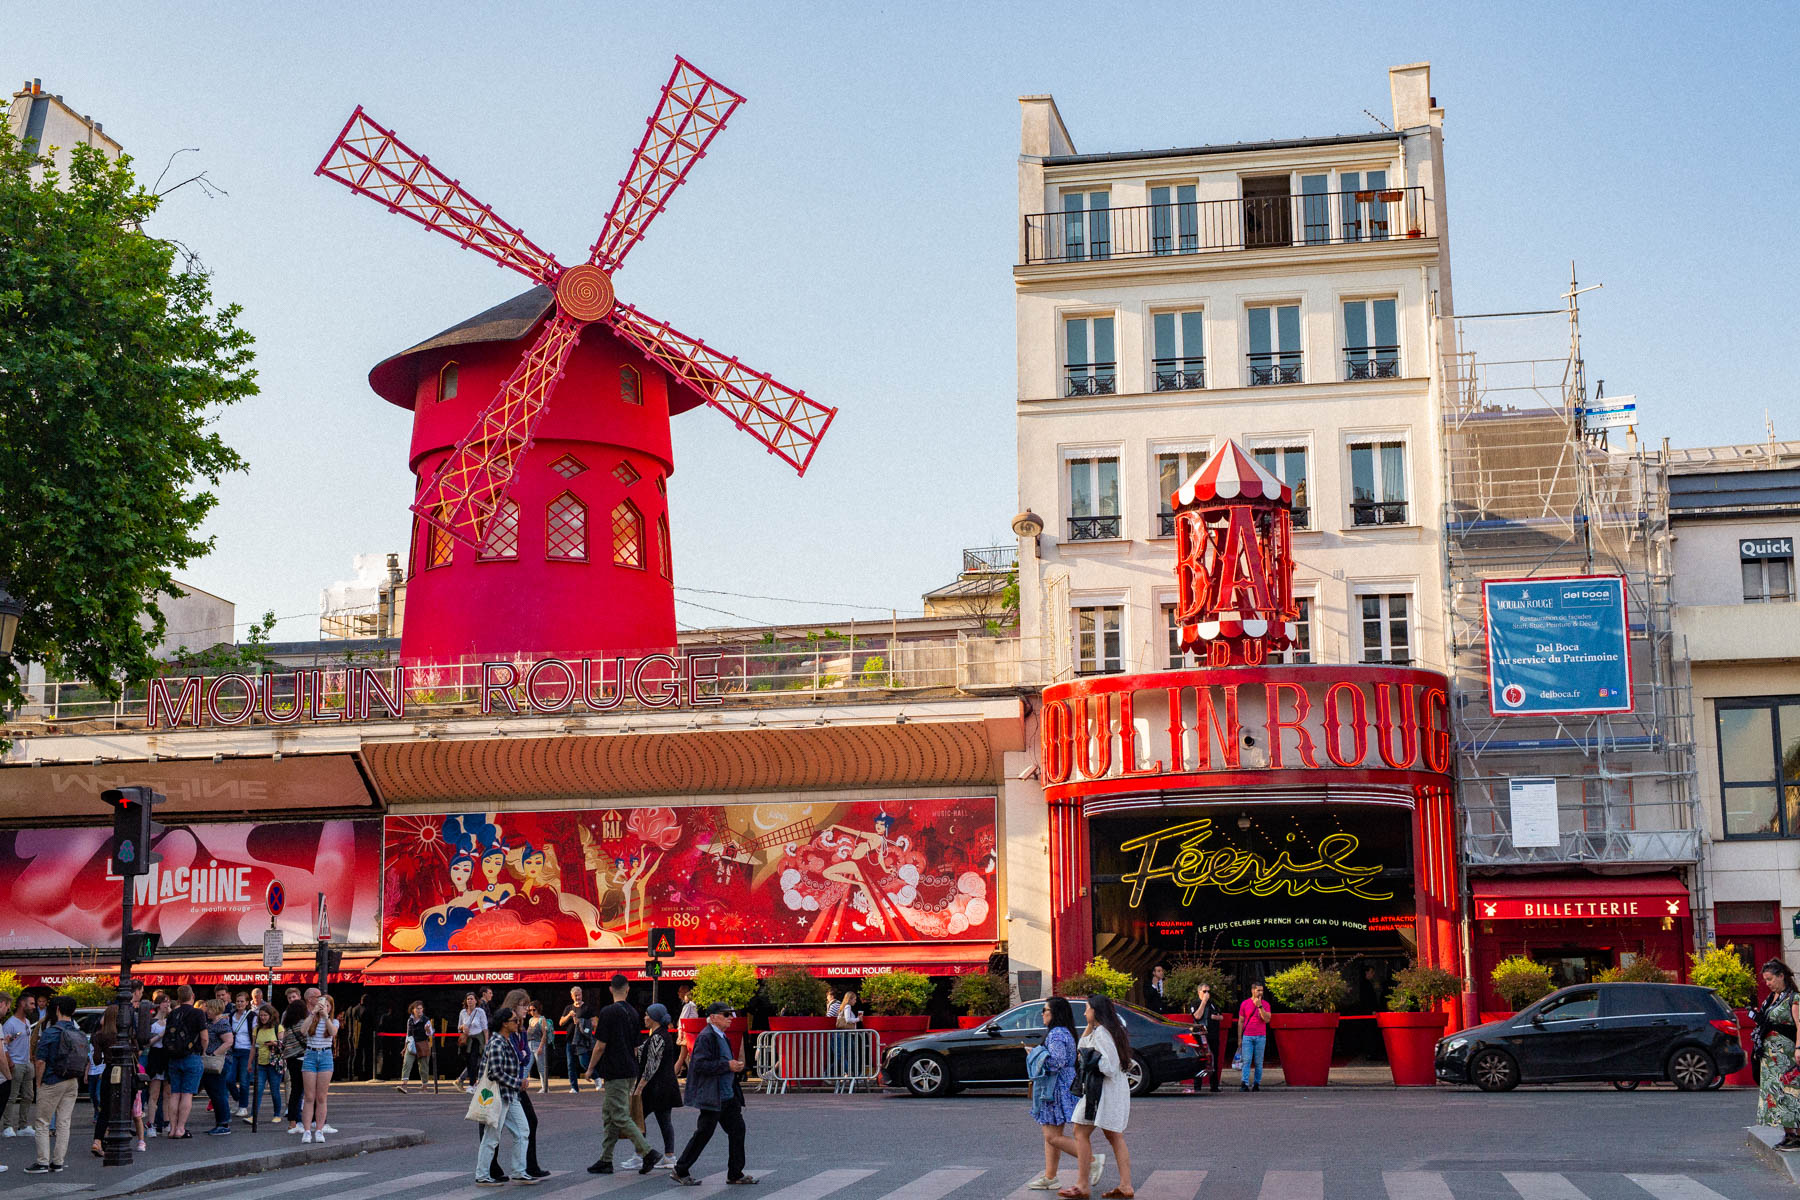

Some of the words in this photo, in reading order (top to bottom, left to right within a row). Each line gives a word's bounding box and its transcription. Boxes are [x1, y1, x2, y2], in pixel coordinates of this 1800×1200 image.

[1741, 540, 1791, 556] Quick
[1174, 505, 1300, 627] BAL
[1563, 591, 1580, 599] del
[1582, 590, 1610, 598] boca
[1497, 600, 1525, 610] MOULIN
[1526, 598, 1553, 609] ROUGE
[1536, 643, 1553, 653] Del
[1556, 642, 1579, 652] Boca
[1499, 657, 1511, 665] au
[1512, 655, 1546, 665] service
[1548, 654, 1561, 664] du
[1563, 651, 1618, 663] Patrimoine
[146, 665, 406, 728] MOULIN
[482, 652, 725, 713] ROUGE
[1540, 689, 1581, 699] delboca.fr
[1041, 683, 1243, 788] OULIN
[1265, 681, 1448, 774] ROUG
[602, 820, 623, 838] BAL
[202, 905, 227, 913] moulin
[229, 905, 251, 913] rouge
[1524, 902, 1638, 916] BILLETTERIE
[667, 912, 700, 931] 1889
[1209, 923, 1229, 932] PLUS
[1263, 917, 1292, 925] FRENCH
[1294, 917, 1310, 925] CAN
[1328, 918, 1340, 927] DU
[1342, 920, 1367, 931] MONDE
[1380, 915, 1416, 923] ATTRACTIO
[1231, 938, 1250, 948] LES
[1254, 938, 1295, 949] DORISS
[1296, 936, 1329, 949] GIRL'S
[638, 970, 669, 979] MOIN
[671, 969, 699, 978] ROUGE
[827, 966, 861, 976] MOULIN
[862, 965, 892, 975] ROUGE
[41, 975, 69, 985] MOULIN
[223, 973, 254, 982] MOULIN
[254, 973, 282, 981] ROUGE
[453, 973, 485, 982] MOULIN
[486, 972, 514, 981] ROUGE
